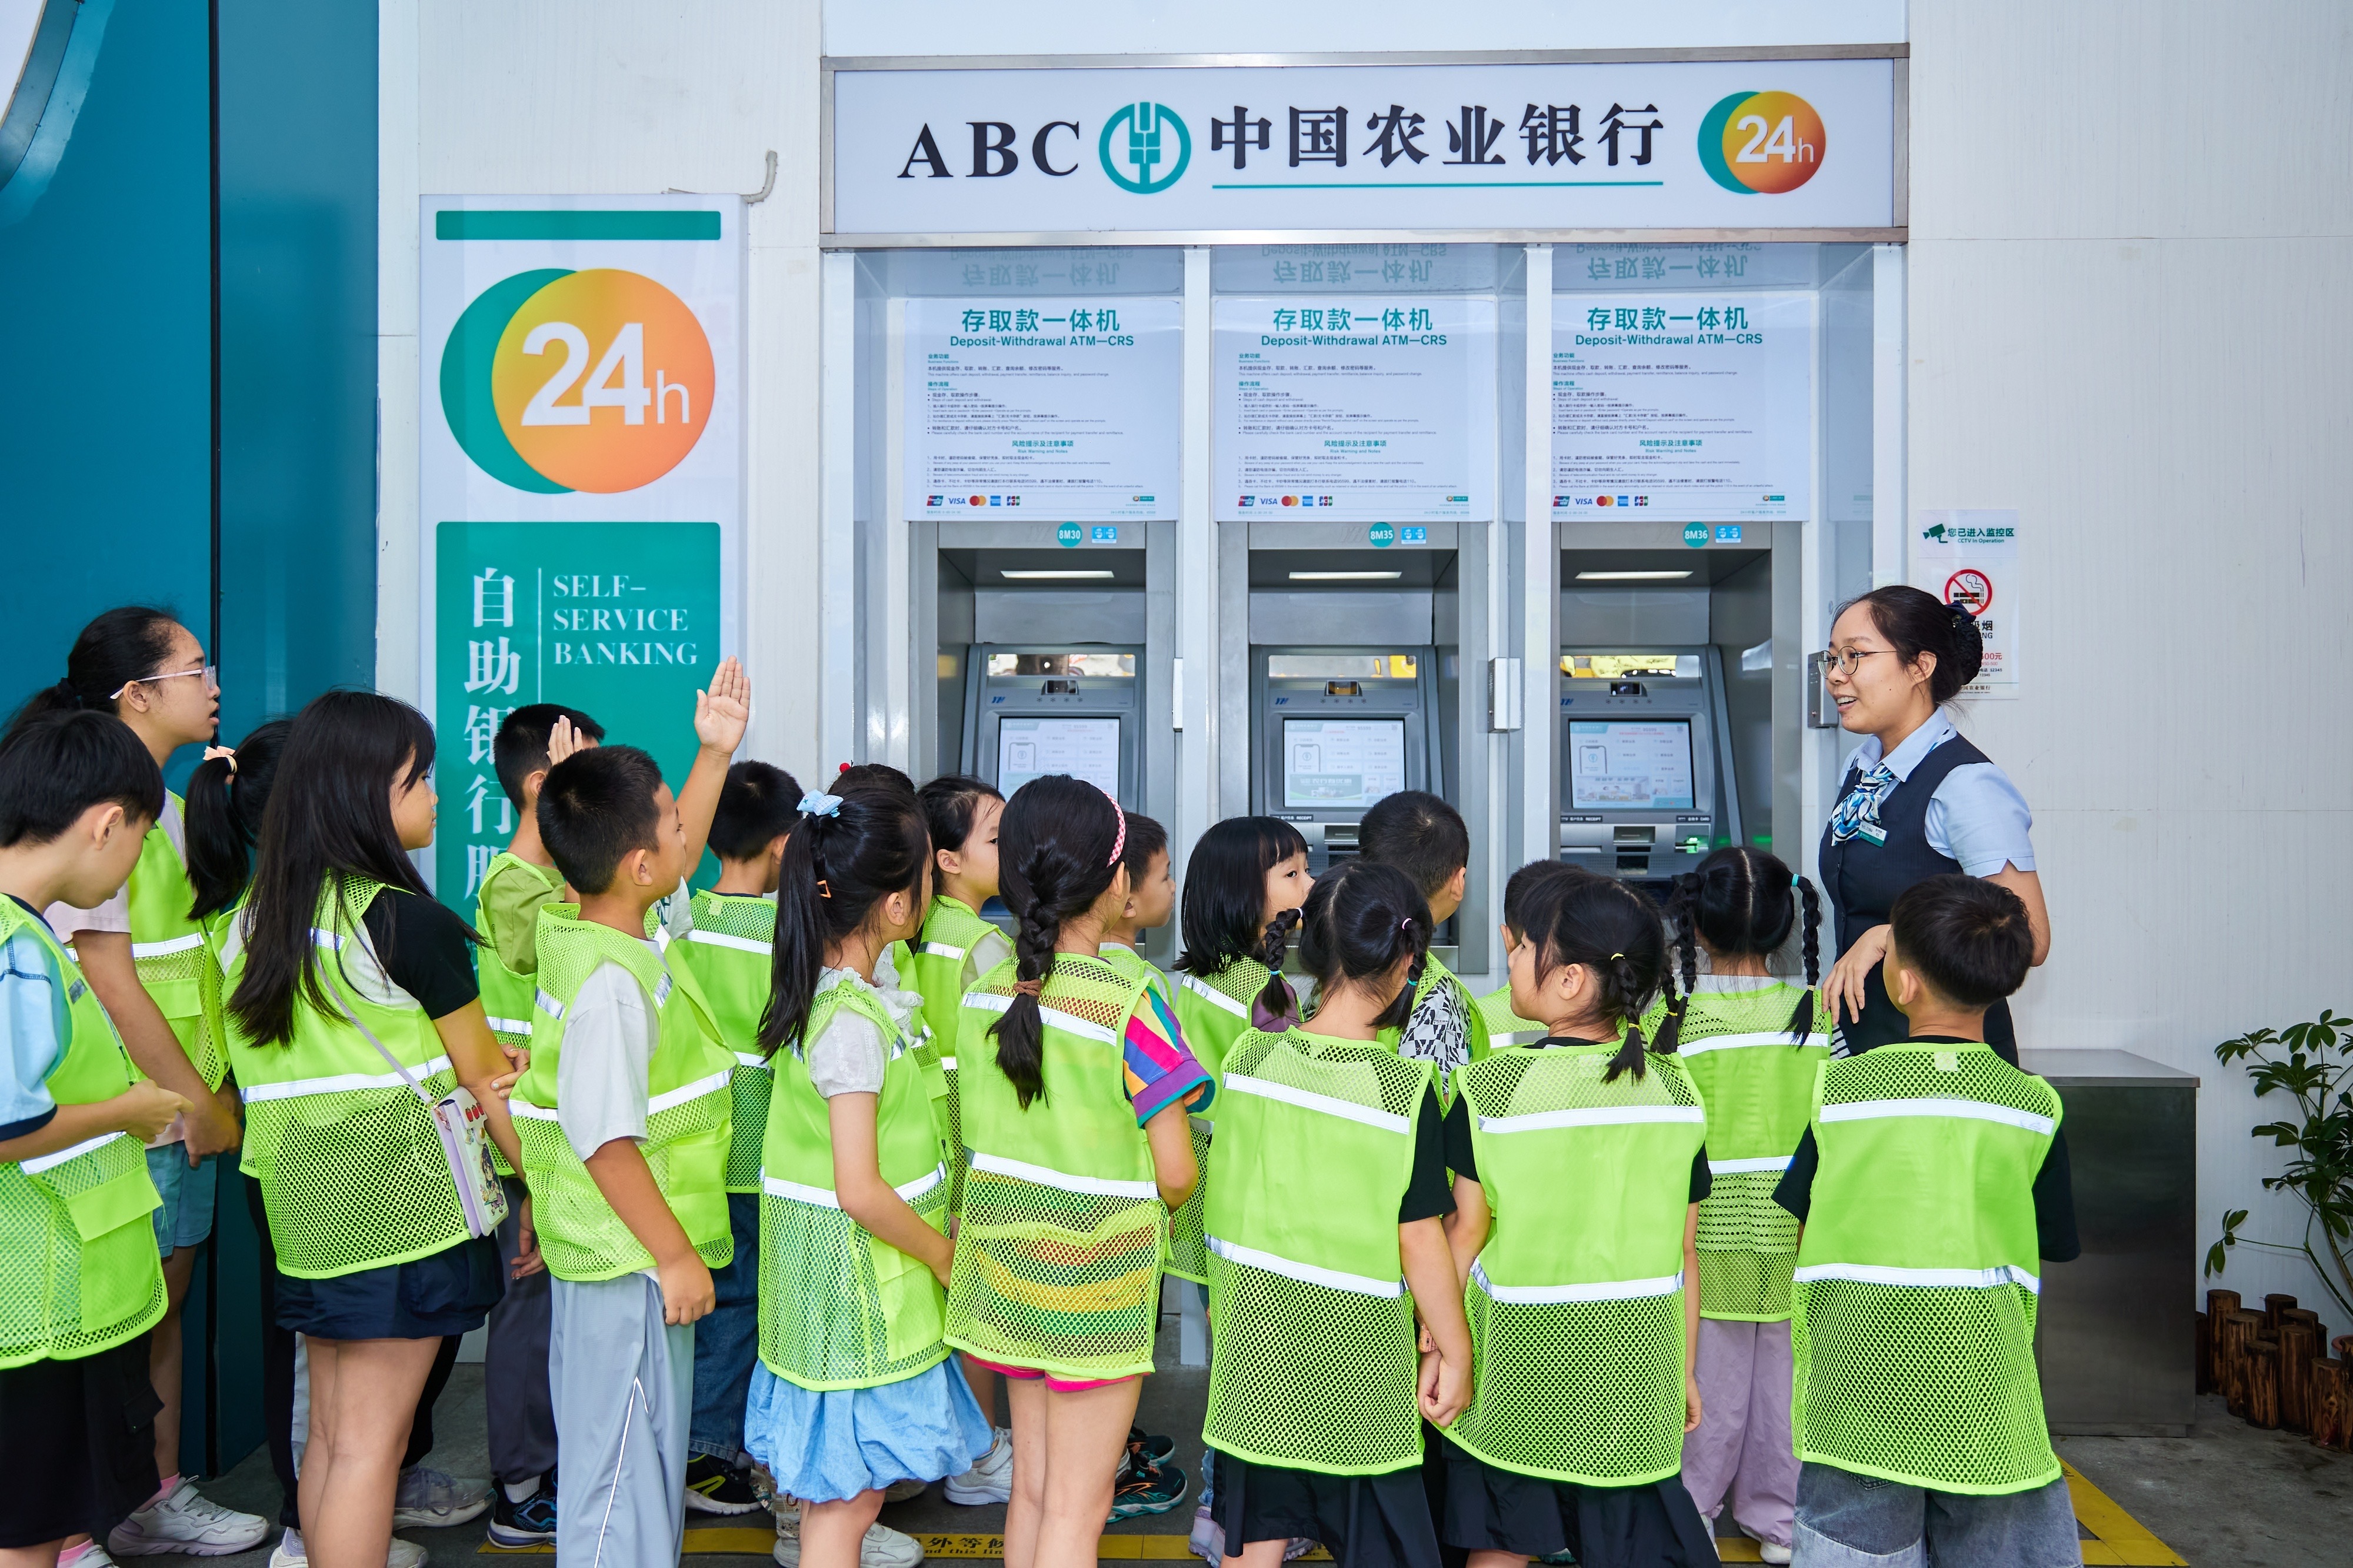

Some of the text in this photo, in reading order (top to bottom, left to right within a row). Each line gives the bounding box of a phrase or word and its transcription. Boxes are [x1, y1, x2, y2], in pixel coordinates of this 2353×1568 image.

[1212, 103, 1664, 166] 中国农业银行
[1736, 115, 1814, 163] 24h
[897, 121, 1079, 178] ABC
[962, 309, 1119, 332] 存取款一体机
[1273, 308, 1432, 331] 存取款一体机
[1587, 308, 1748, 330] 存取款一体机
[951, 336, 1066, 348] Deposit-Withdrawal
[1262, 335, 1378, 347] Deposit-Withdrawal
[1576, 333, 1694, 346] Deposit-Withdrawal
[521, 322, 689, 426] 24h
[1059, 530, 1081, 539] 8M30
[1371, 530, 1394, 540] 8M35
[1684, 530, 1708, 540] 8M36
[1948, 528, 2014, 537] 您已进入监控区
[554, 609, 688, 631] SERVICE
[554, 643, 697, 665] BANKING
